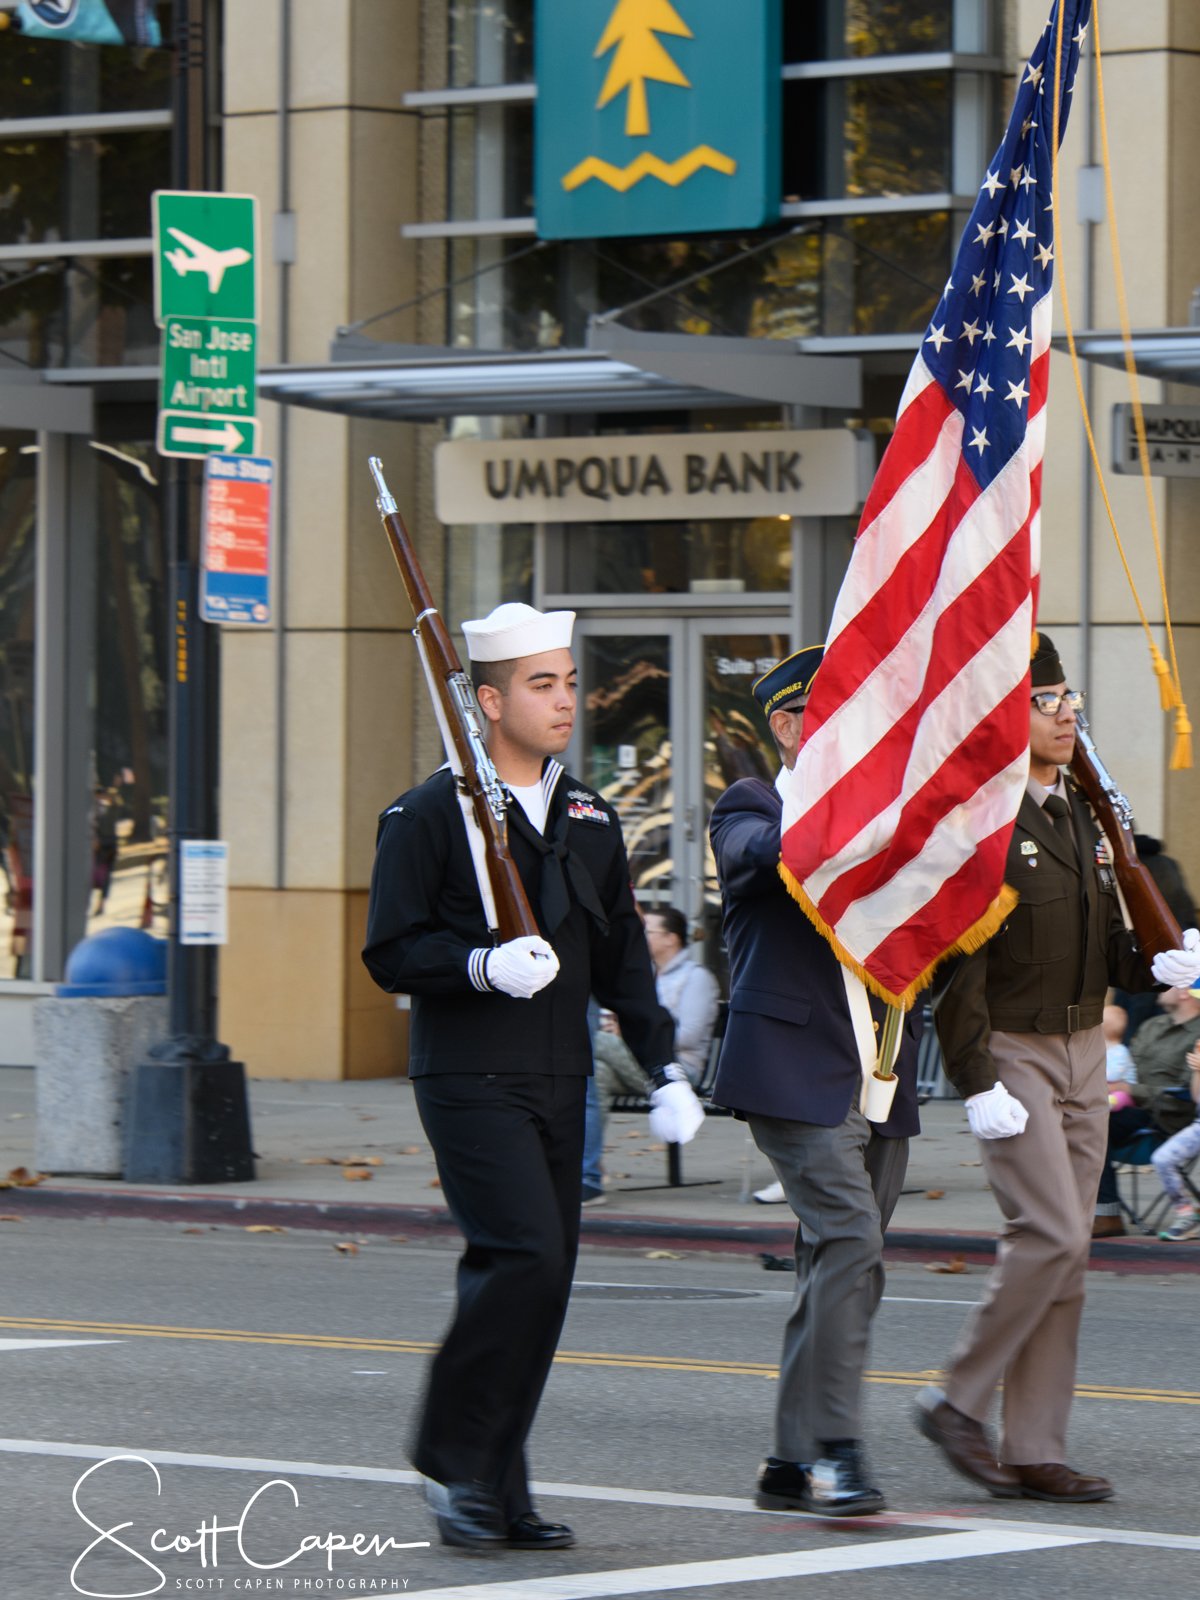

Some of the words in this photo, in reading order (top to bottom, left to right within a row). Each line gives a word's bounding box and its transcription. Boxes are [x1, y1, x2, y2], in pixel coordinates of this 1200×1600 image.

[169, 323, 202, 349] San
[206, 326, 253, 352] Jose
[190, 353, 228, 380] Intl
[170, 380, 248, 411] Airport
[208, 457, 238, 476] Bus
[239, 459, 272, 482] Stop
[484, 453, 671, 501] UMPQUA
[684, 451, 803, 495] BANK
[717, 657, 755, 675] Suite
[772, 681, 803, 703] RODRIGUEZ
